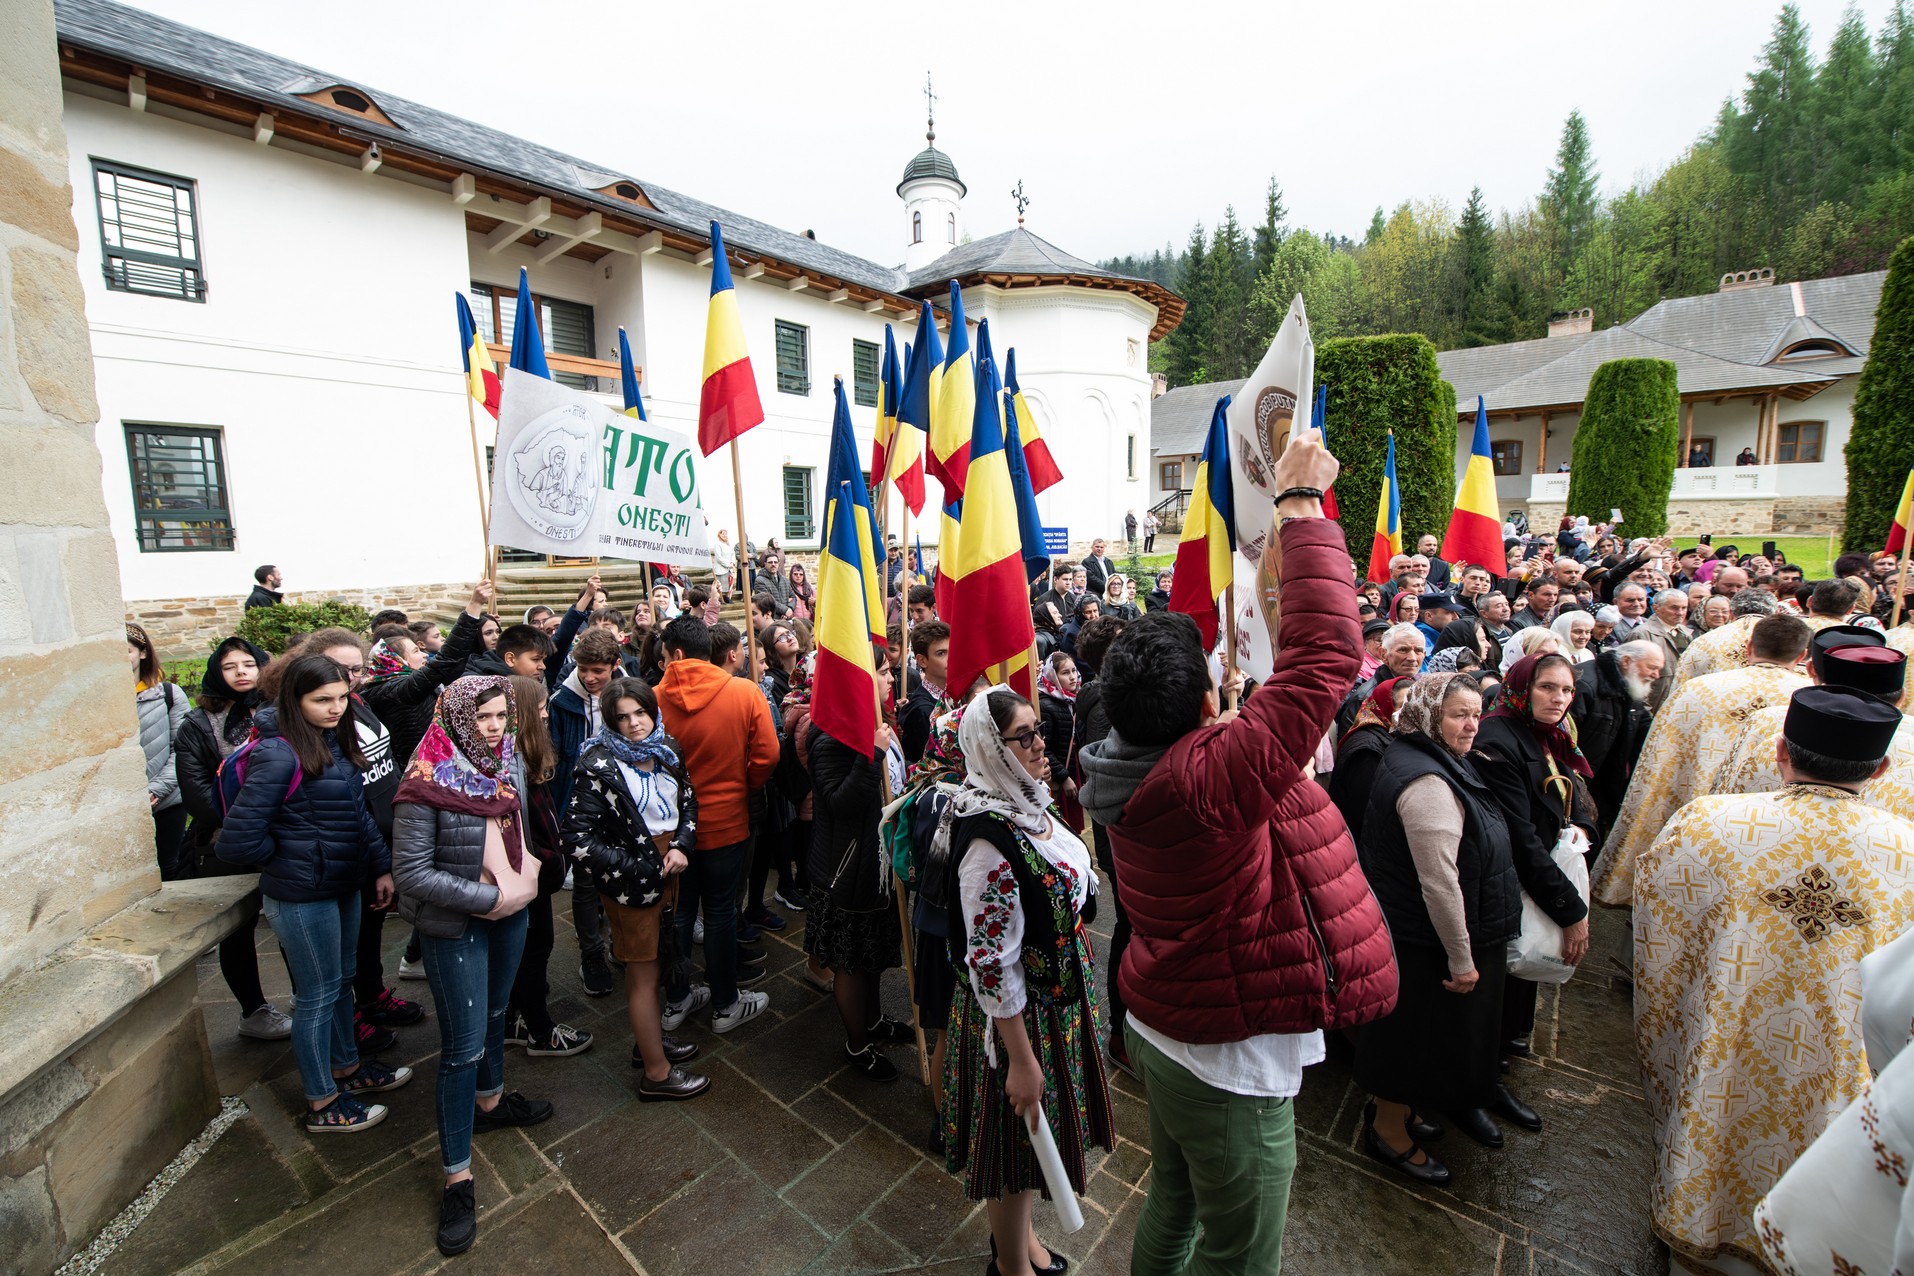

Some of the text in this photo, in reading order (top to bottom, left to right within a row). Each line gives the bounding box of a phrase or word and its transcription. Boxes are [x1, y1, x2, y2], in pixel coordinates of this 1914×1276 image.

[602, 423, 701, 509] ATO
[617, 503, 691, 539] ONEȘTI
[361, 758, 394, 786] adida
